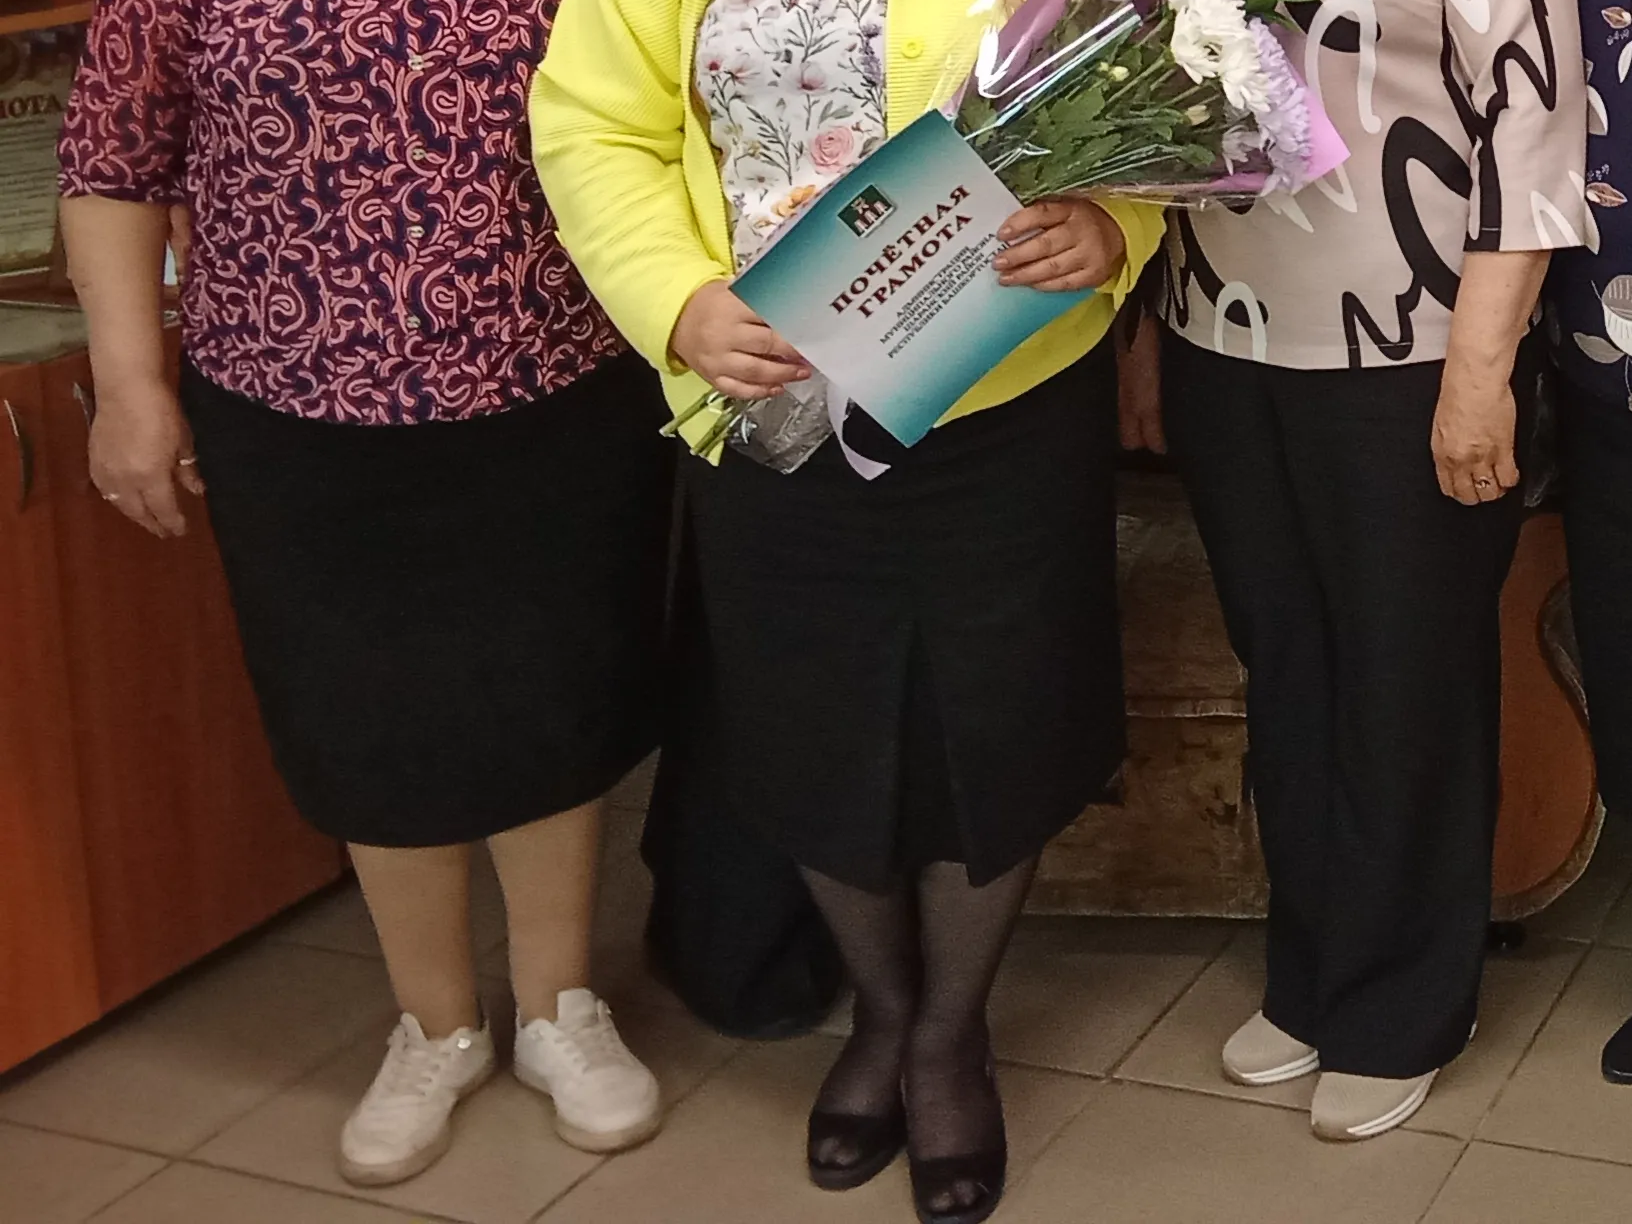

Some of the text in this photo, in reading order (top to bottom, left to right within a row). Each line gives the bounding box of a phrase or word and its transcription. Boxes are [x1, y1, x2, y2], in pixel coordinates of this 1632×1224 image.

[829, 184, 972, 314] ПОЧЁТНАЯ
[857, 212, 974, 319] ГРАМОТА
[879, 233, 996, 344] МУНИЦИПАЛЬНОГО РАЙОНА
[896, 246, 972, 318] АДМИНИСТРАЦИИ
[903, 252, 985, 332] ШАРАНСКИЙ РАЙОН
[887, 305, 943, 359] РЕСПУБЛИКИ
